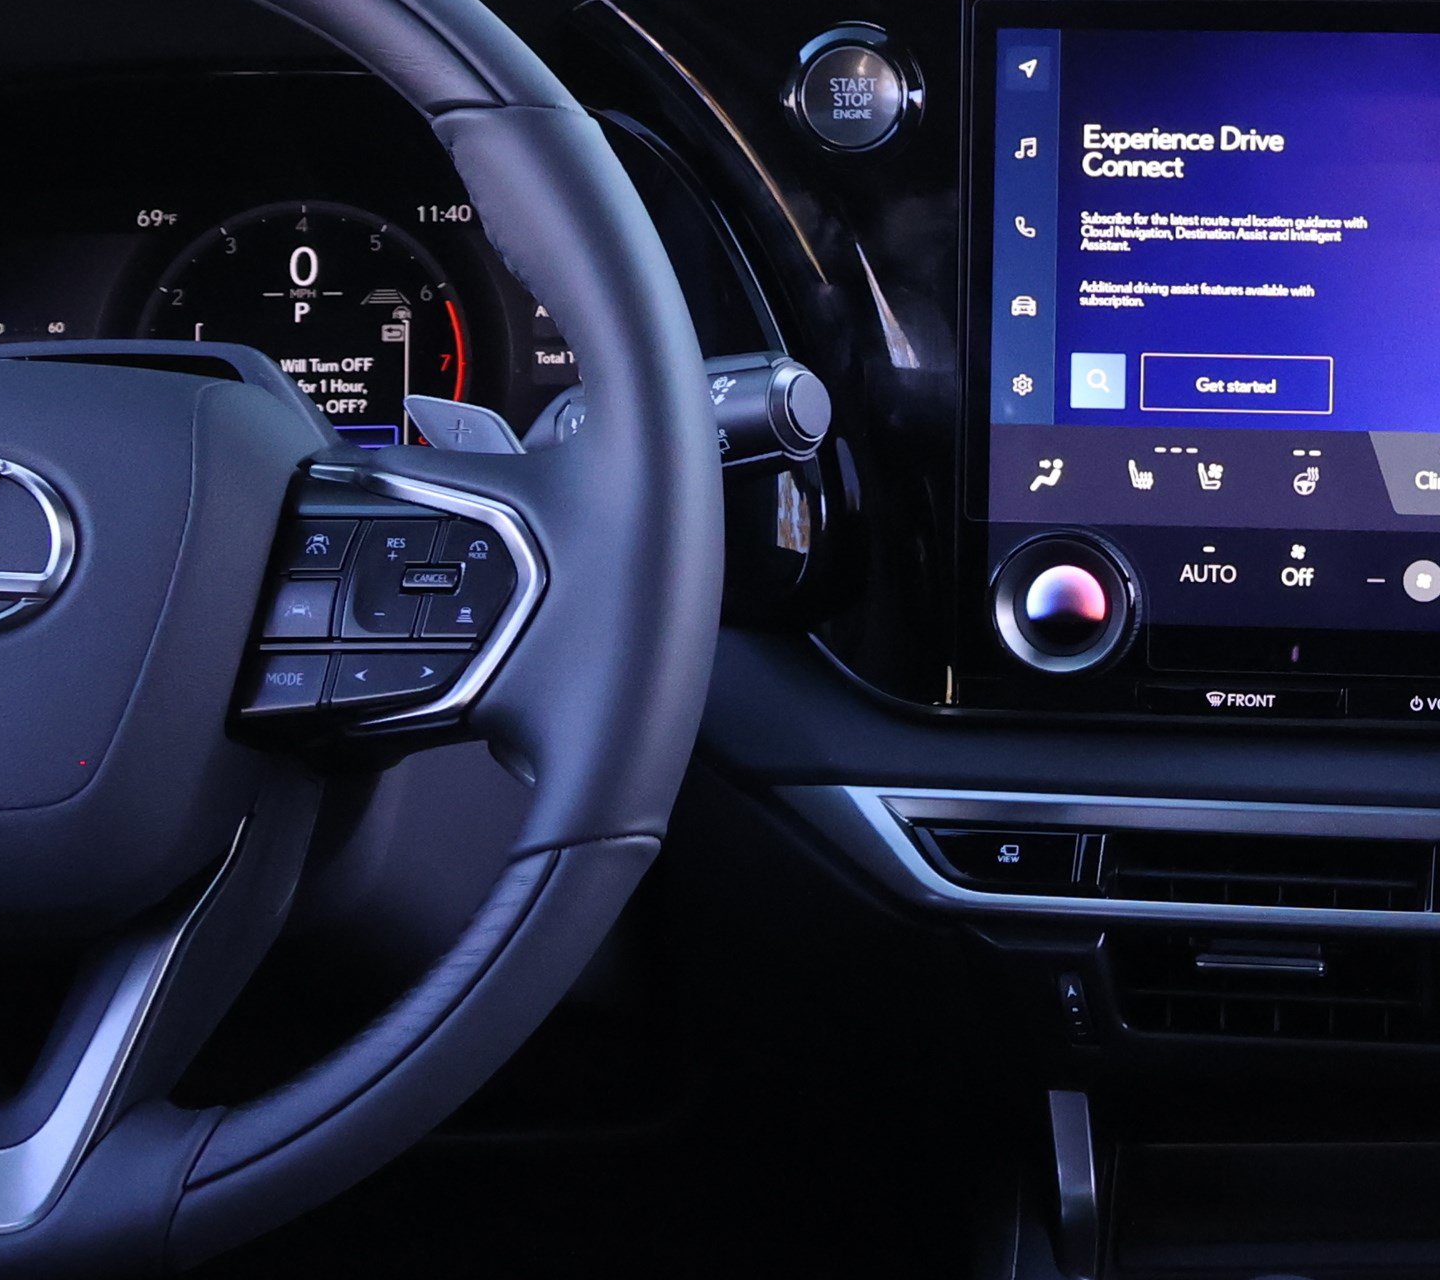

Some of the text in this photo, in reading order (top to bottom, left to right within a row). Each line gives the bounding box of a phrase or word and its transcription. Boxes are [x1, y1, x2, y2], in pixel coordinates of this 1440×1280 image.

[829, 78, 878, 92] START
[832, 93, 873, 107] STOP
[833, 109, 872, 119] ENGINE
[1083, 124, 1285, 155] Experience Drive
[1082, 152, 1185, 179] Connect
[416, 204, 472, 223] 11:40
[1080, 211, 1368, 230] Subscribe for the latest route and location guidance with
[295, 217, 308, 232] 4
[1080, 225, 1342, 244] Cloud Navigation, Destination Assist and Intelligent
[225, 237, 237, 254] 3
[370, 235, 382, 251] 5
[1080, 238, 1131, 251] Assistant.
[289, 246, 319, 287] 0
[289, 289, 317, 299] MPH
[419, 285, 433, 302] 6
[1079, 280, 1316, 297] Additional driving assist features available with
[171, 289, 183, 306] 2
[1079, 294, 1145, 309] subscription.
[294, 302, 311, 323] P
[47, 321, 66, 334] 60
[280, 357, 375, 373] Will Turn OFF
[440, 354, 452, 372] 7
[535, 351, 565, 365] Total
[320, 379, 368, 395] 1 Hour,
[1195, 377, 1277, 395] Get started
[326, 399, 368, 414] OFF?
[386, 537, 406, 549] RES
[413, 573, 449, 584] CANCEL
[1179, 564, 1237, 584] AUTO
[1281, 567, 1314, 587] Off
[265, 672, 305, 686] MODE
[1227, 693, 1276, 708] FRONT
[997, 855, 1020, 863] VIEW
